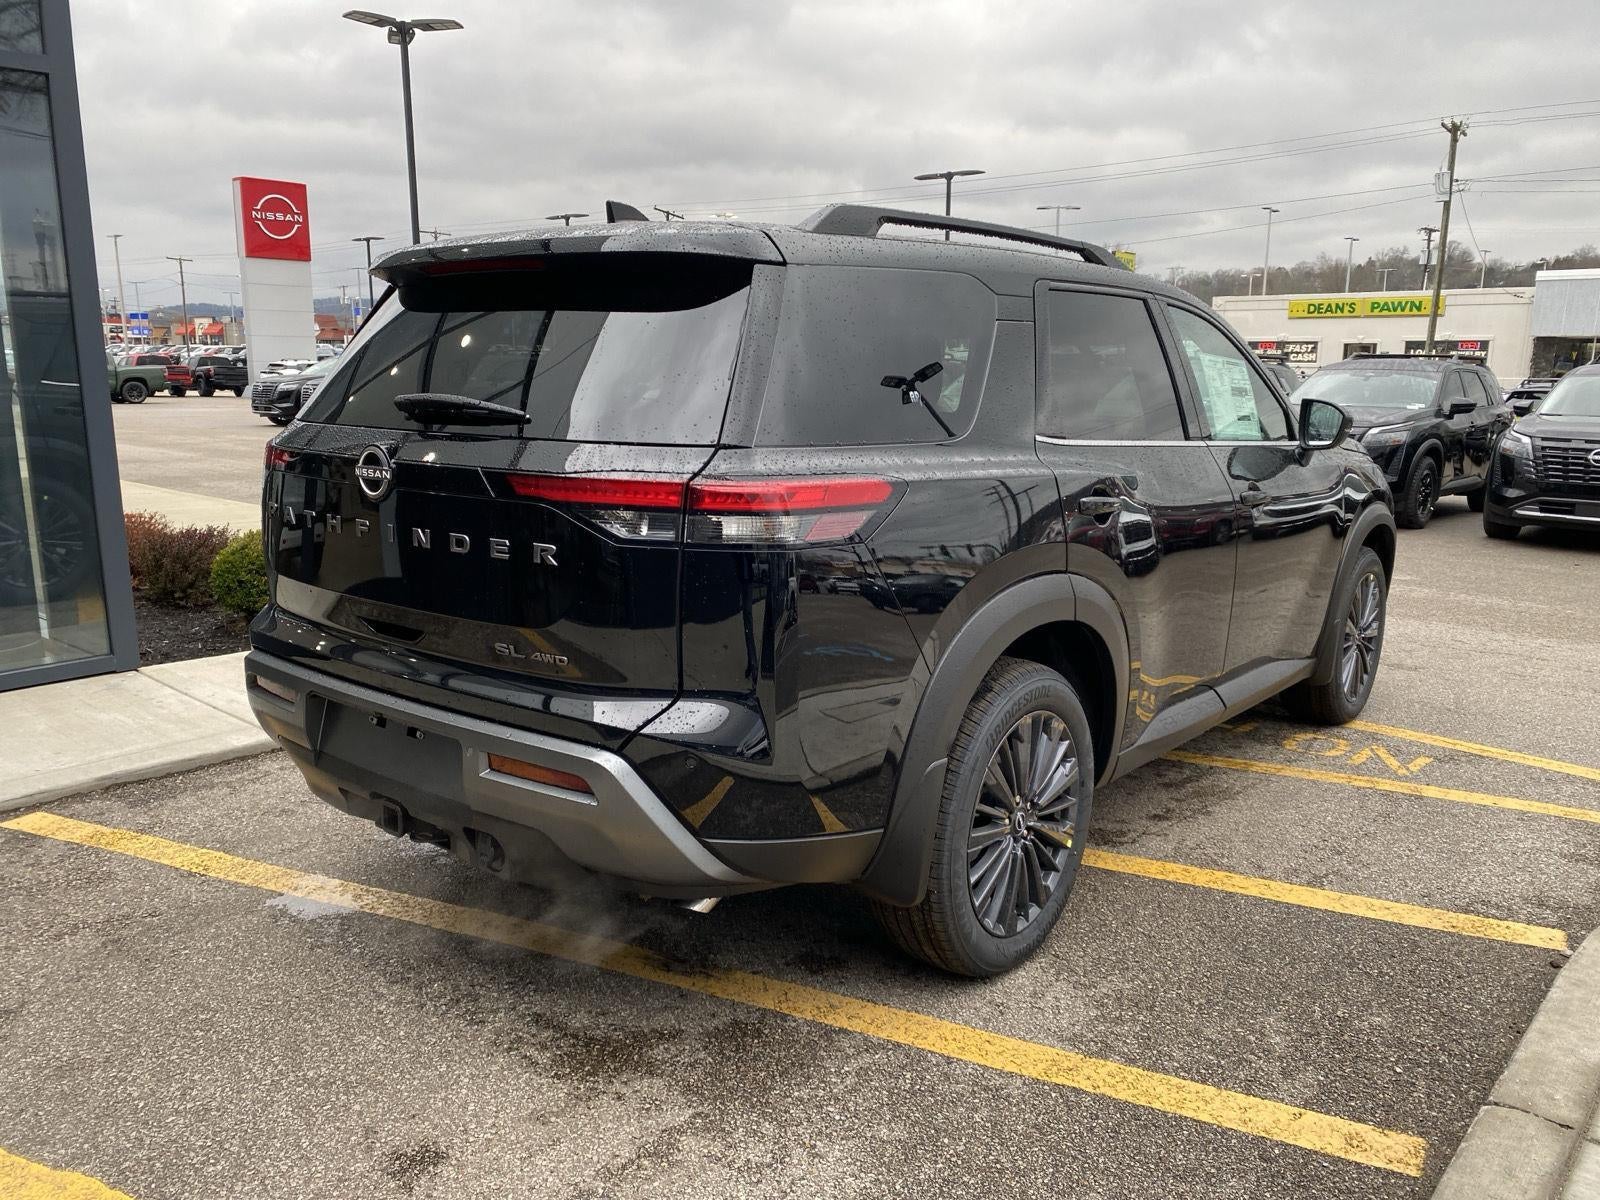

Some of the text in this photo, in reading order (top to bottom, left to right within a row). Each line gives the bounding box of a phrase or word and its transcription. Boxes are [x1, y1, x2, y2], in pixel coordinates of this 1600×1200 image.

[252, 210, 303, 223] NISSAN
[1307, 300, 1424, 315] DEAN'S PAWN
[1288, 344, 1315, 353] FAST
[1290, 353, 1317, 361] CASH
[355, 467, 391, 480] NISSAN
[268, 500, 558, 567] PATHFINDER
[494, 642, 526, 660] SL
[985, 684, 1052, 751] BRIDGESTONE
